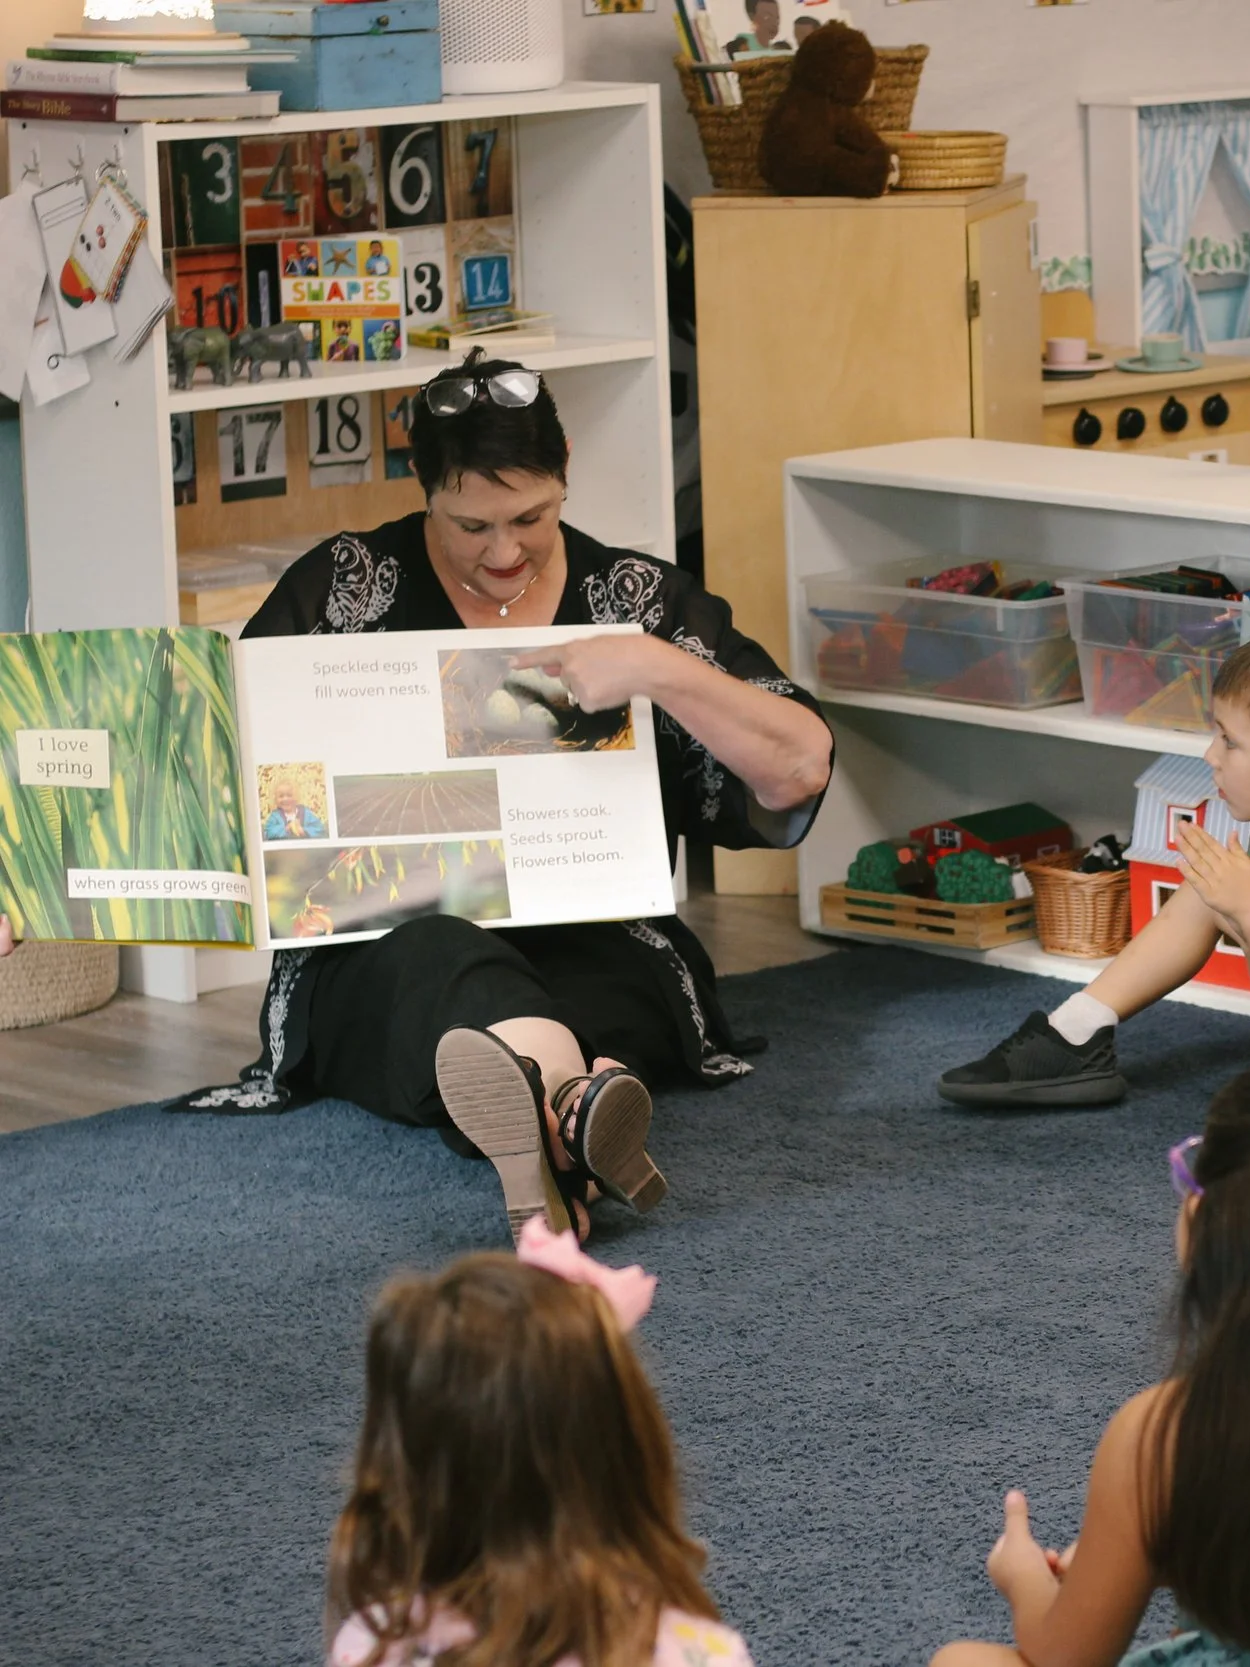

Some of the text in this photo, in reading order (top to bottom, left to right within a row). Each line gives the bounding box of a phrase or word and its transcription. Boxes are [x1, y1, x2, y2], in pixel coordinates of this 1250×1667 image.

[42, 100, 71, 116] Bible
[201, 142, 235, 204] 3
[388, 126, 434, 216] 6
[466, 128, 499, 197] 7
[262, 142, 300, 214] 4
[326, 132, 368, 219] 5
[292, 280, 391, 302] SHAPES
[471, 262, 504, 302] 14
[315, 396, 362, 455] 18
[219, 410, 282, 477] 17
[313, 660, 419, 678] Speckled eggs
[315, 684, 430, 699] fill woven nests.
[39, 737, 88, 752] I love
[36, 760, 93, 779] spring
[507, 804, 611, 822] Showers soak.
[510, 829, 607, 846] Seeds sprout.
[512, 850, 624, 869] Flowers bloom.
[74, 876, 249, 896] when grass grows green.
